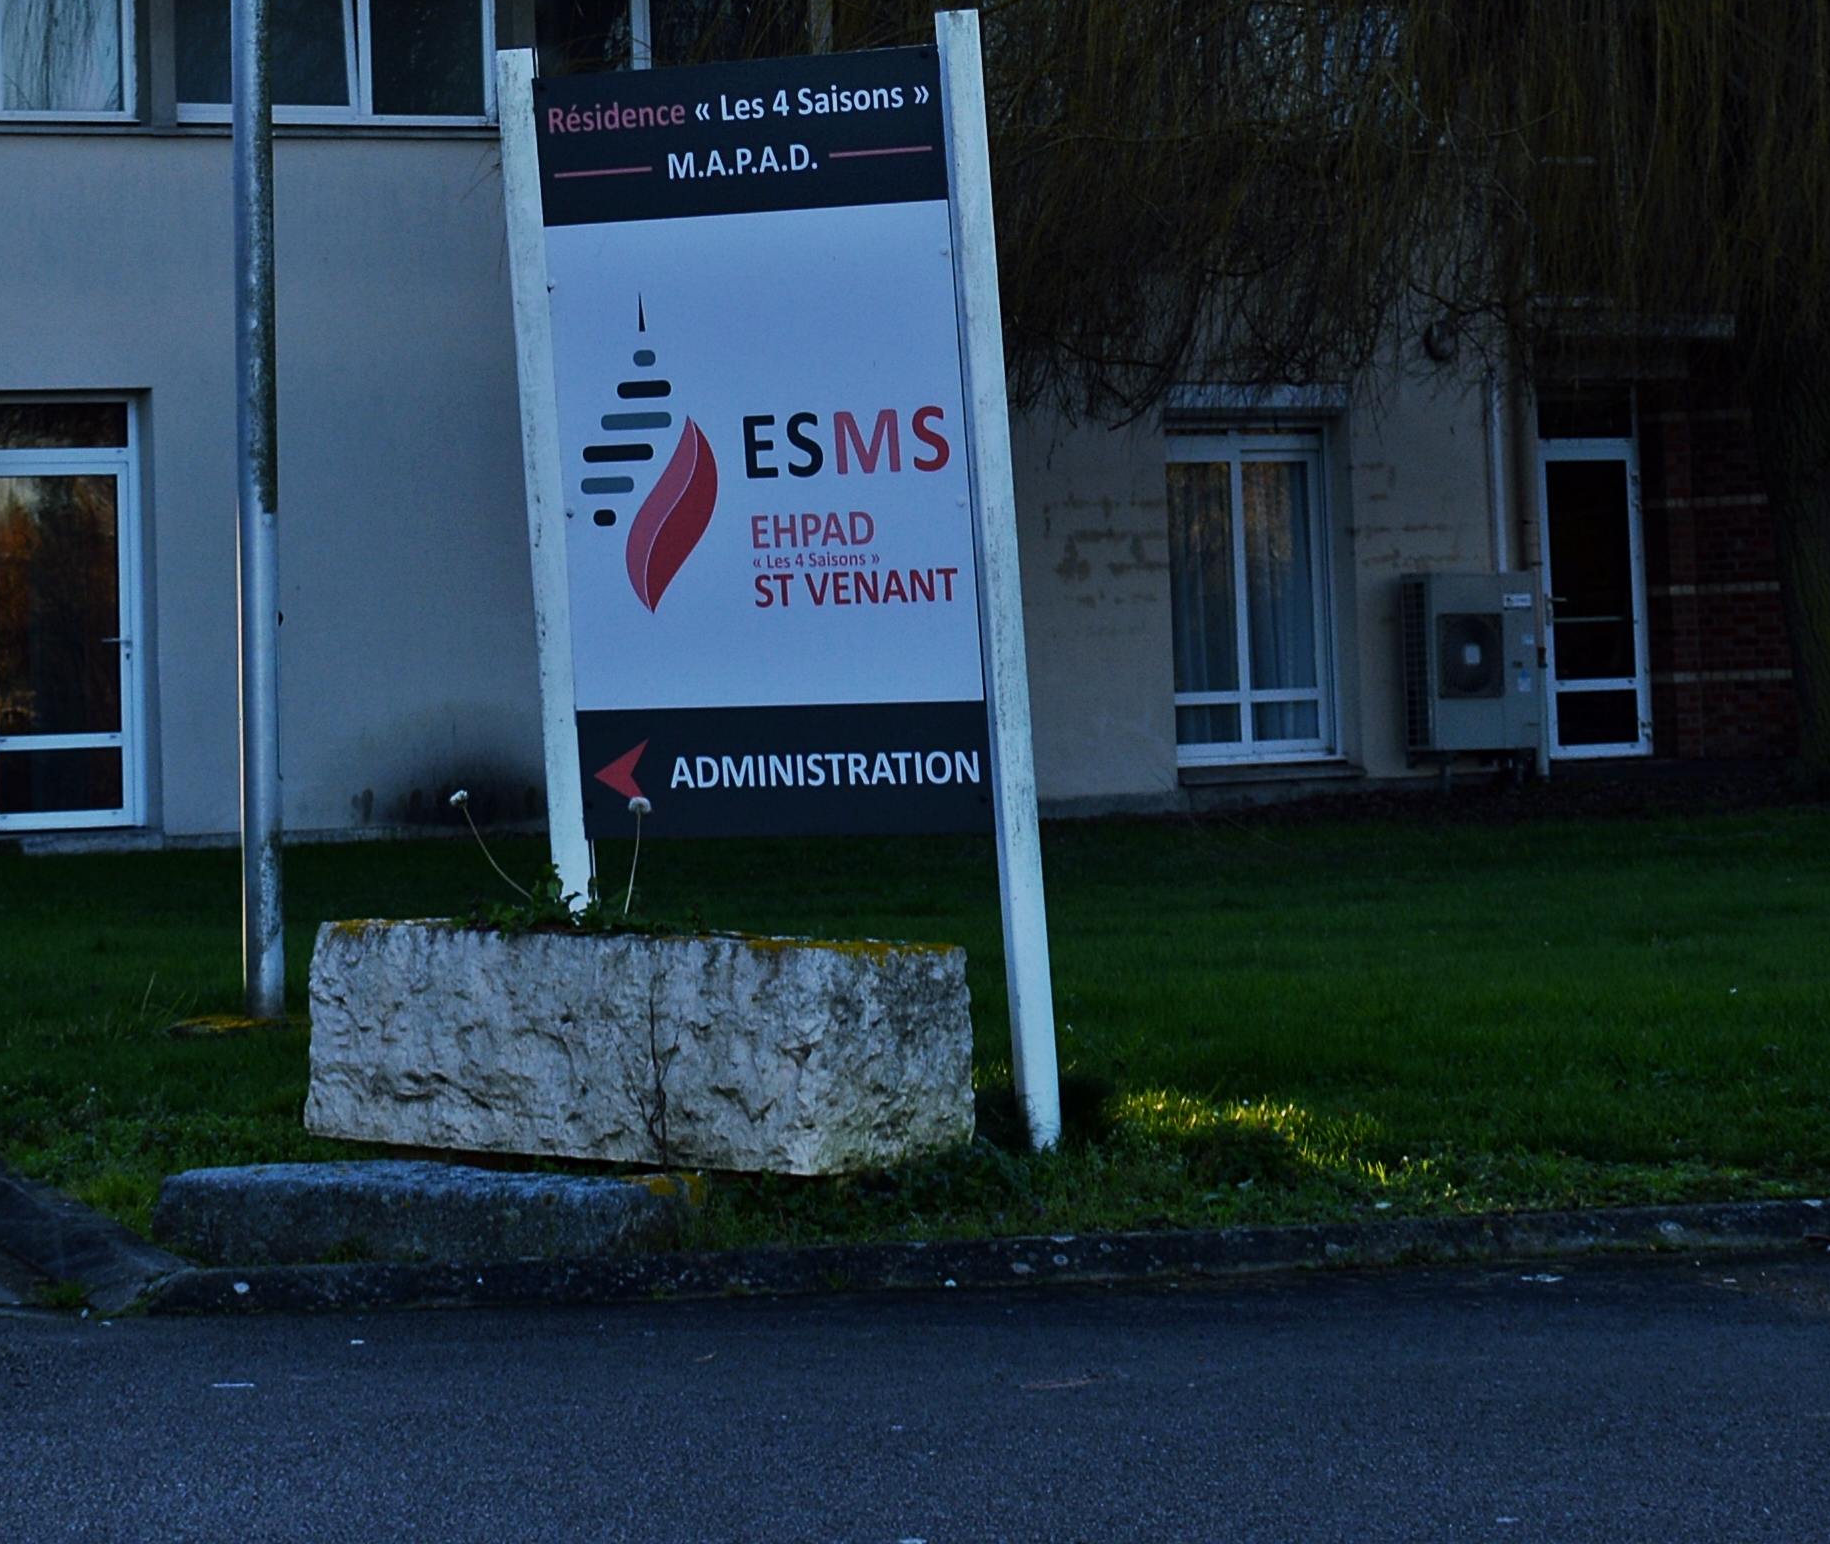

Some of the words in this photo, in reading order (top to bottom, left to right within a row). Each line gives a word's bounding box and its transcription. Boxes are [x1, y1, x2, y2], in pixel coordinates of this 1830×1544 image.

[547, 101, 686, 134] Résidence
[720, 93, 765, 122] Les
[772, 89, 790, 117] 4
[797, 84, 905, 116] Saisons
[667, 143, 819, 180] M.A.P.A.D.
[742, 405, 951, 480] ESMS
[751, 511, 875, 550] EHPAD
[766, 553, 791, 569] Les
[795, 553, 804, 568] 4
[808, 551, 867, 568] Saisons
[754, 573, 795, 608] ST
[804, 567, 959, 607] VENANT
[670, 751, 981, 790] ADMINISTRATION
